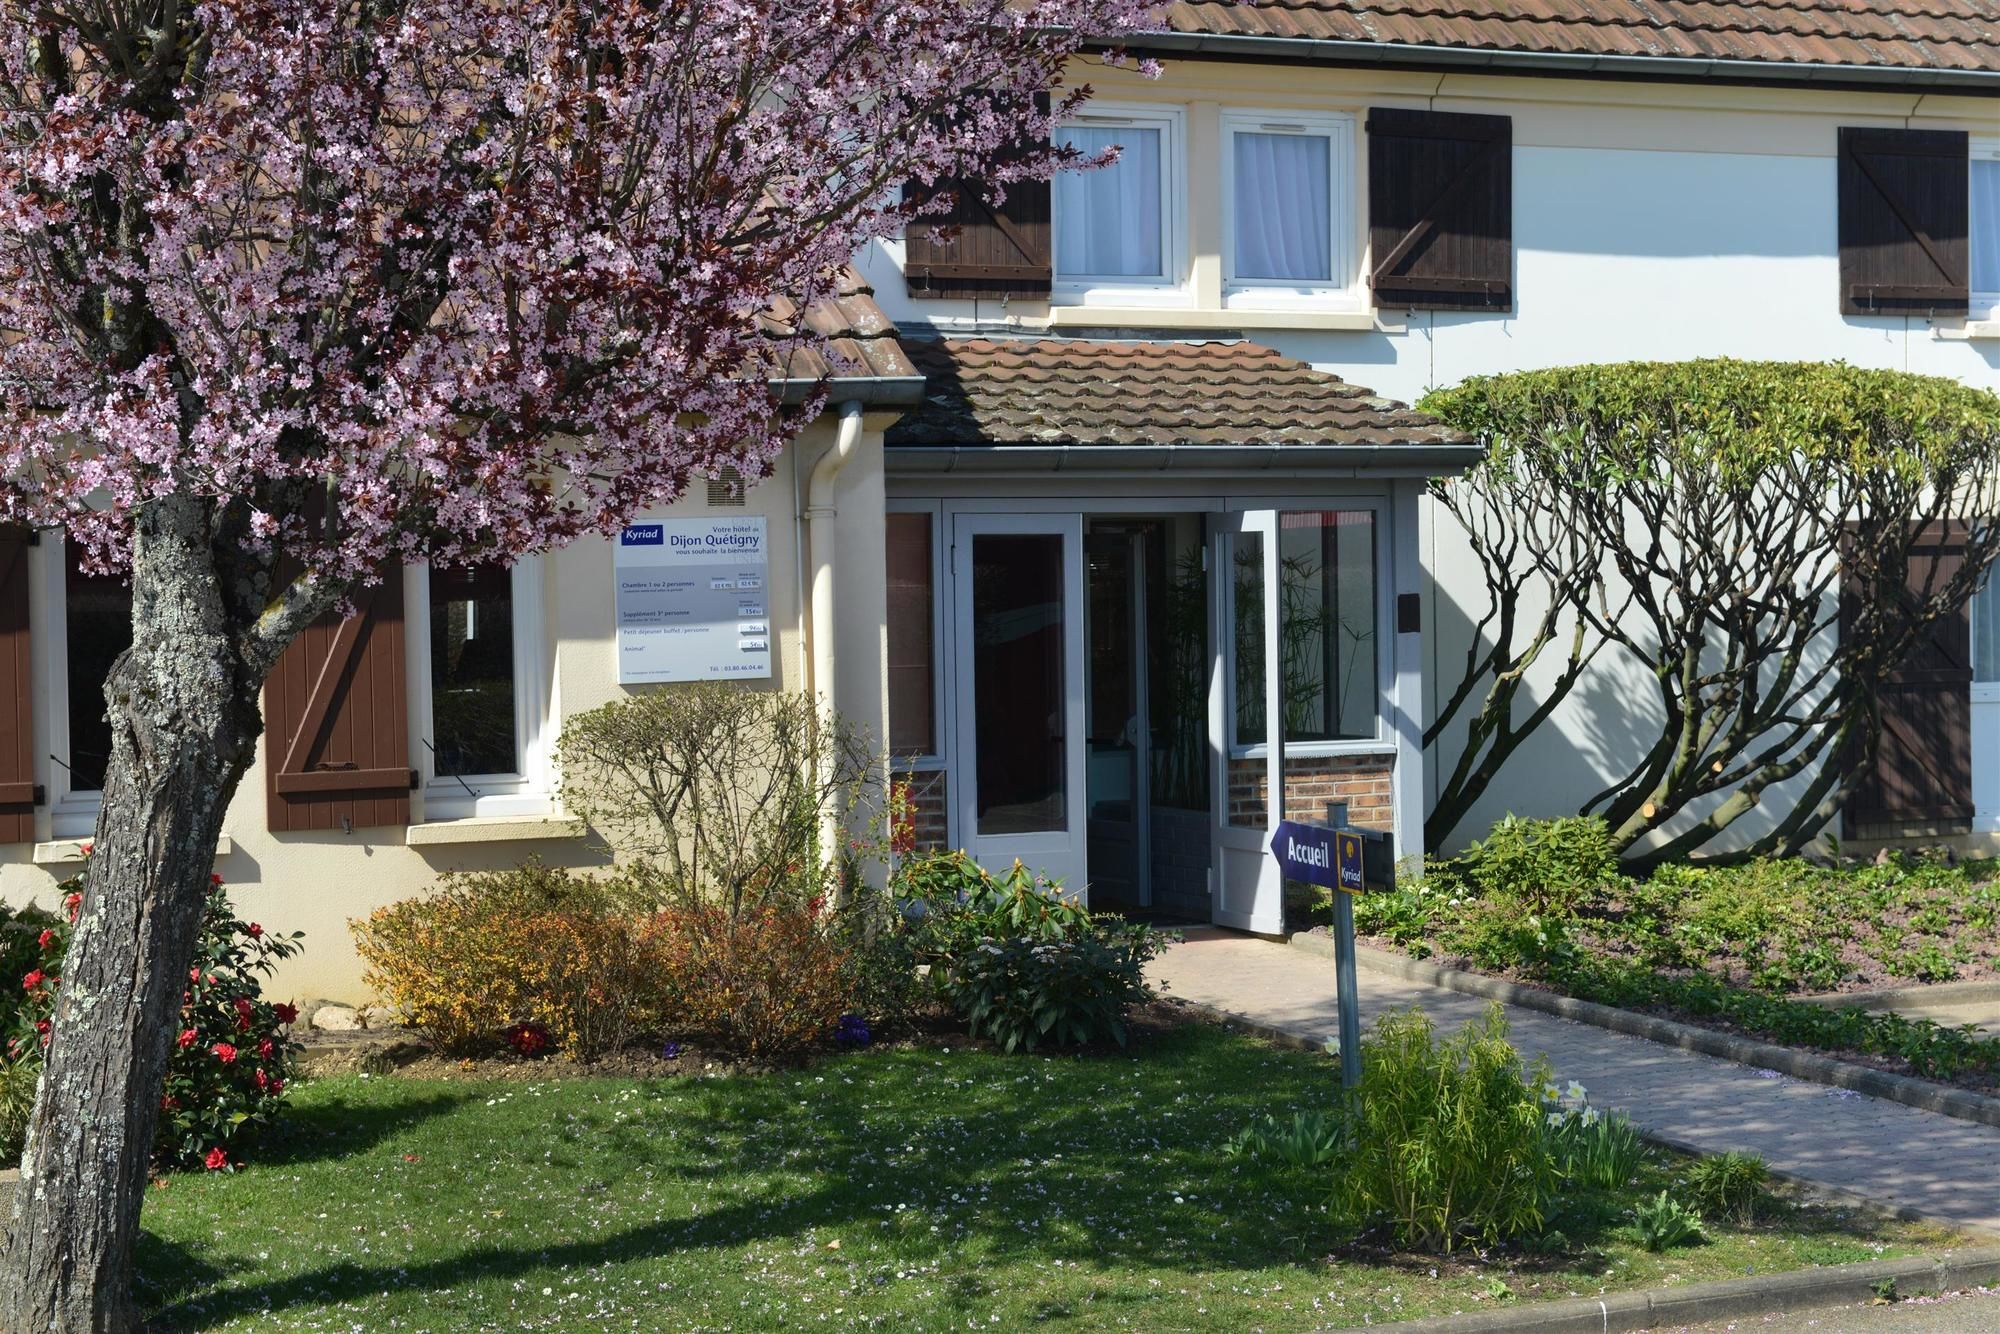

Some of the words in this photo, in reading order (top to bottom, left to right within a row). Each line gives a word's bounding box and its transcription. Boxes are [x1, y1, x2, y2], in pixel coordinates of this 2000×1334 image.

[626, 530, 658, 540] Kyriad
[670, 535, 702, 548] Dijon
[706, 534, 759, 547] Quétigny
[1288, 836, 1329, 868] Accueil
[1341, 867, 1360, 882] Kyriad
